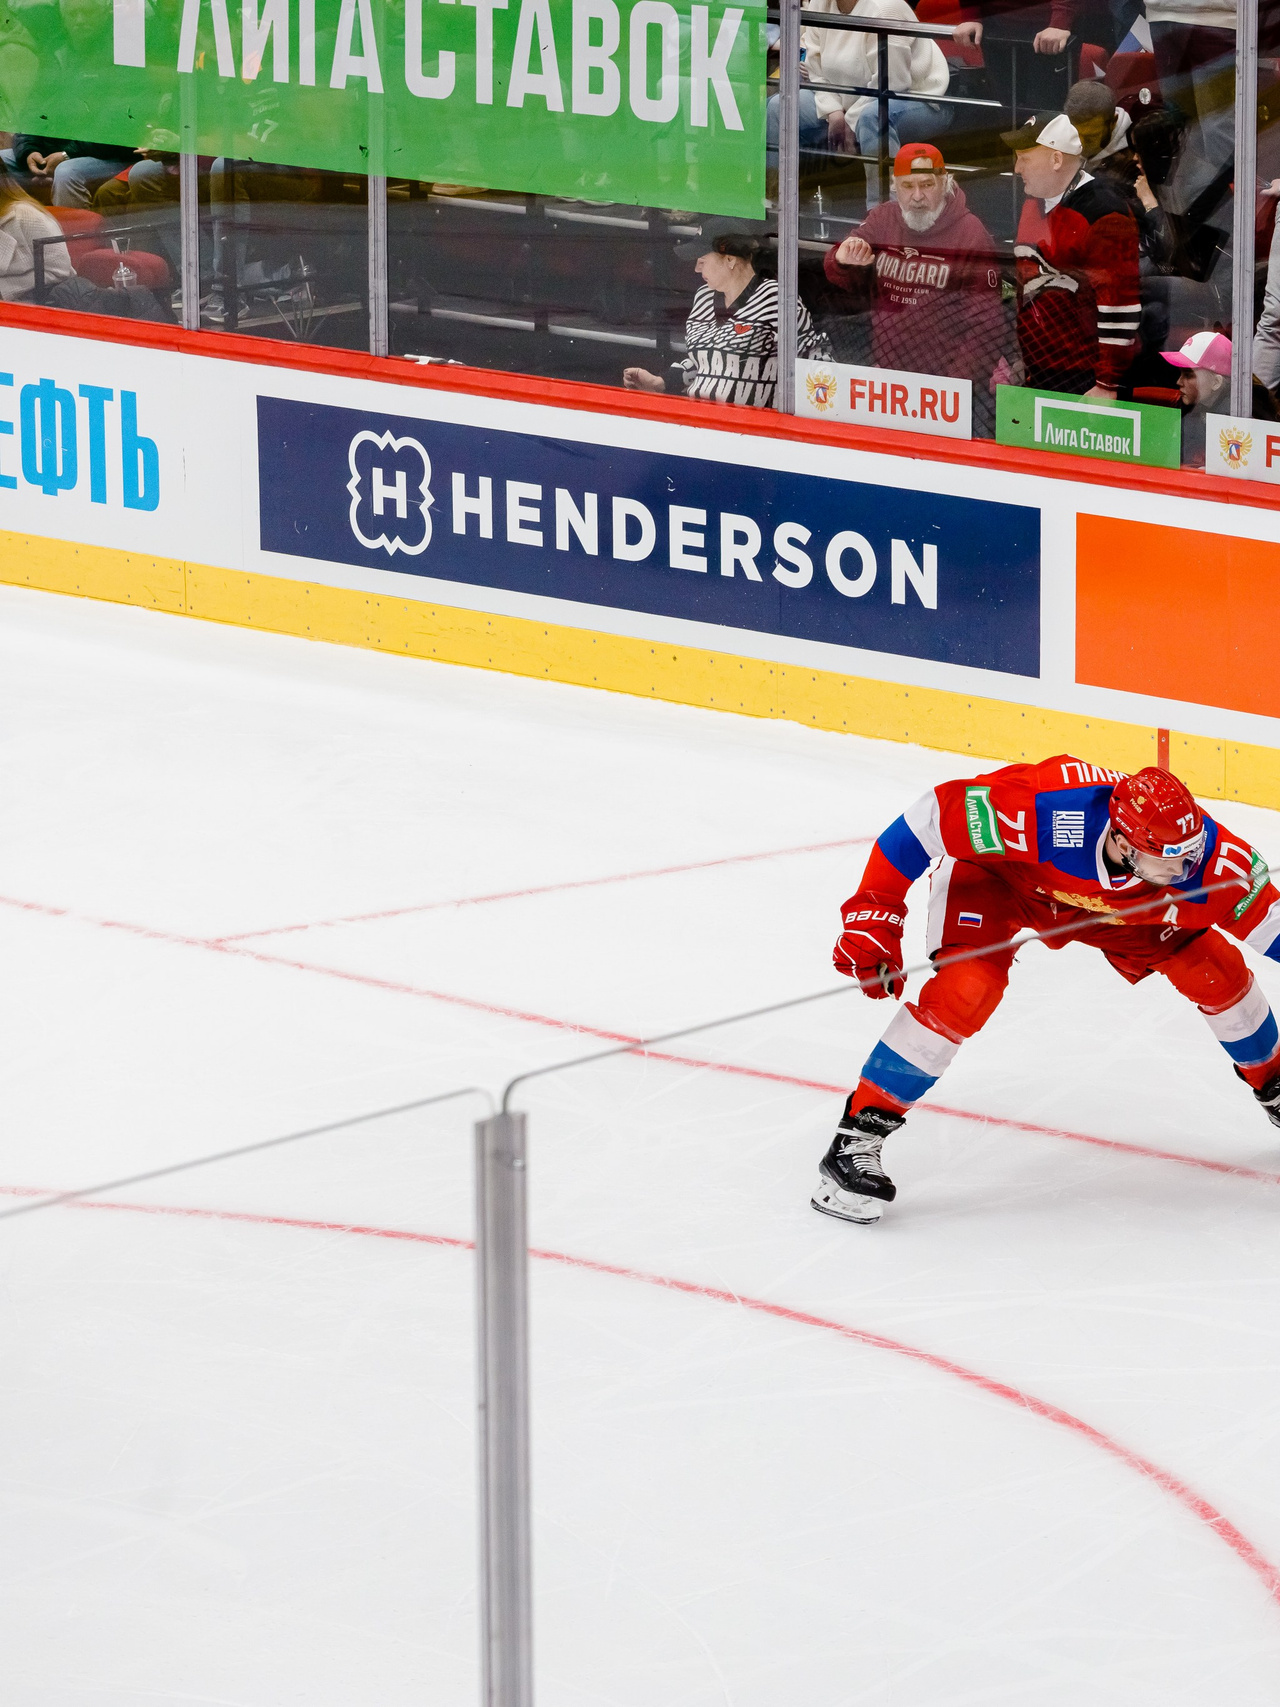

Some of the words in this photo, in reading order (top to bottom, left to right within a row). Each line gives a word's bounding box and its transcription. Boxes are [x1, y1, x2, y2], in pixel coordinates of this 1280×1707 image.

[405, 0, 746, 131] СТАВОК
[848, 378, 960, 424] FHR.RU
[451, 472, 938, 610] HENDERSON
[1060, 762, 1130, 785] HVILI
[997, 811, 1028, 852] 77
[1176, 812, 1195, 835] 77
[1214, 841, 1253, 893] 77
